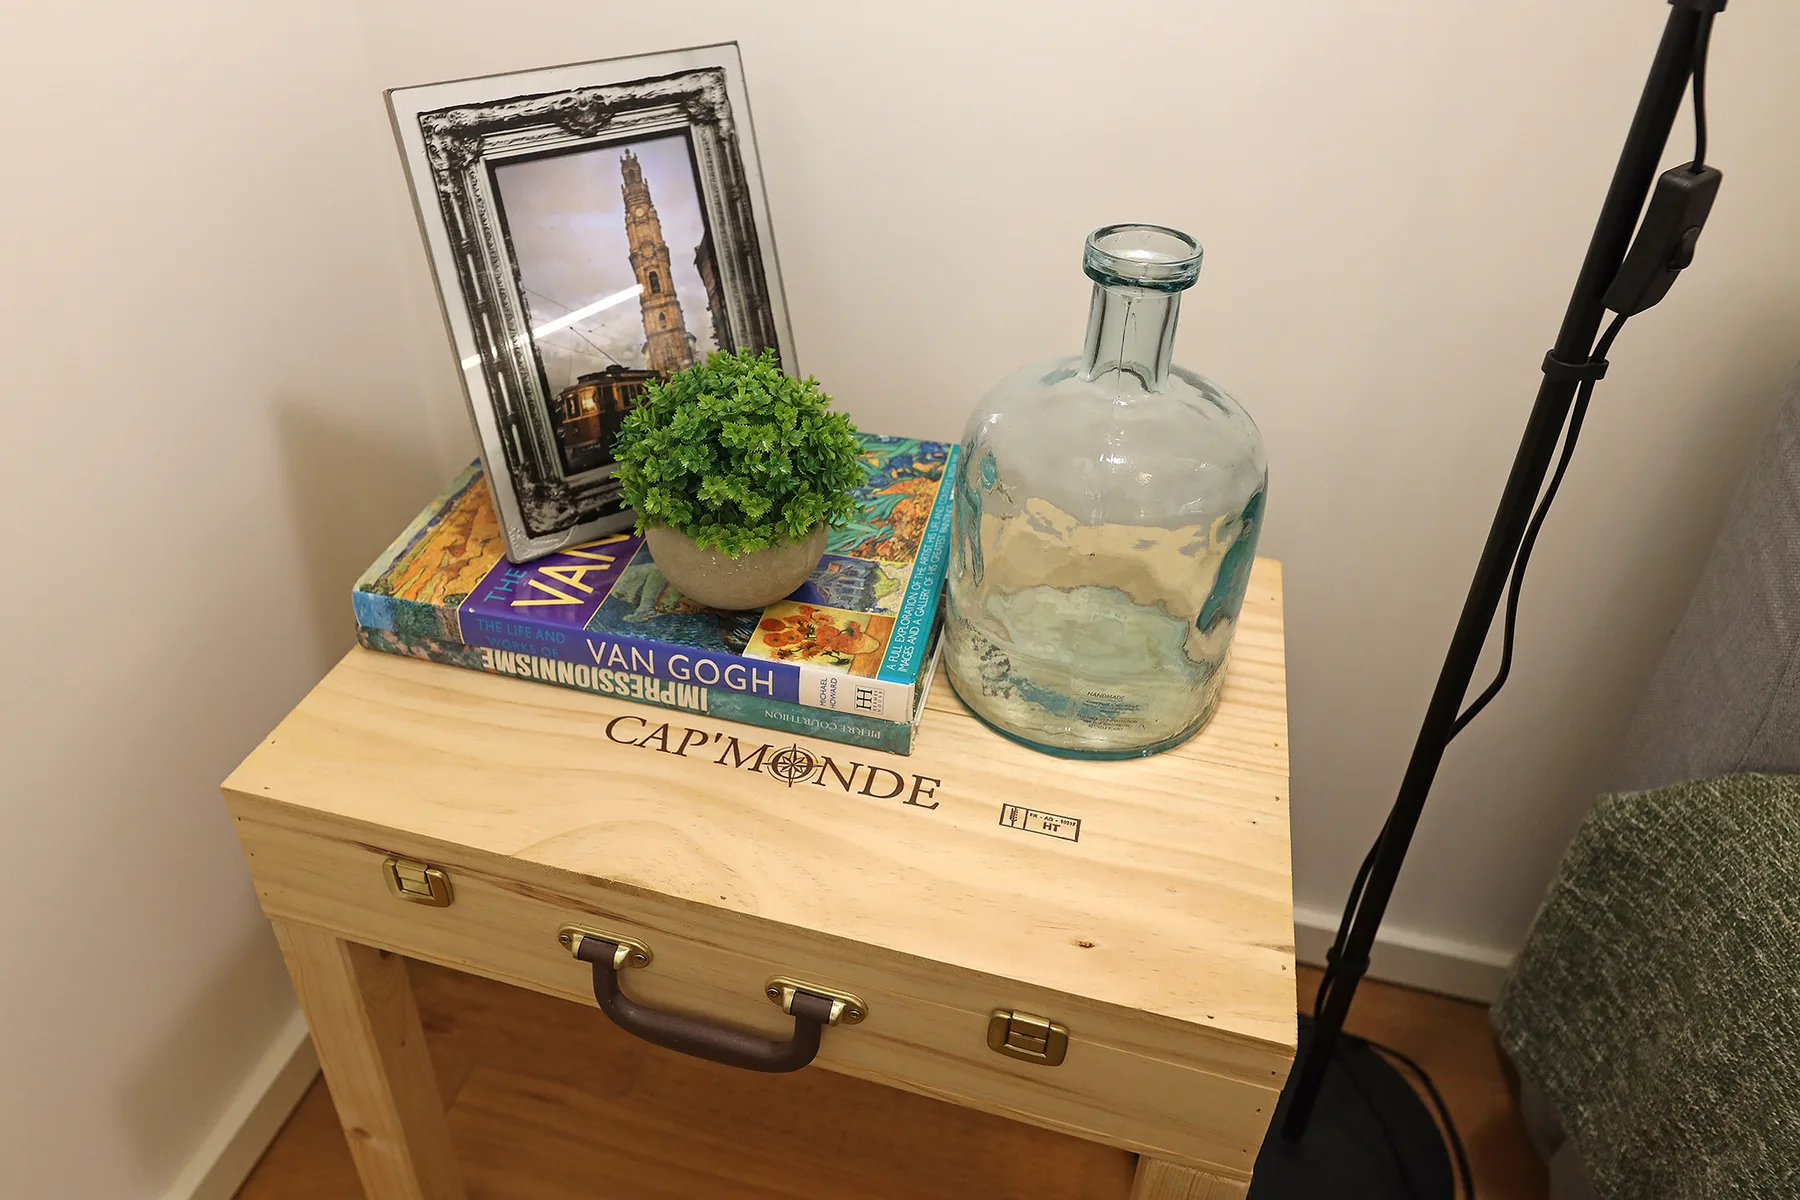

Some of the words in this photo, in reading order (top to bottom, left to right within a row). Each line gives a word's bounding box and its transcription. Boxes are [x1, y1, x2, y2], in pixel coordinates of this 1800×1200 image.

[483, 567, 527, 603] THE
[911, 582, 922, 591] OF
[914, 566, 927, 580] THE
[476, 619, 502, 633] THE
[506, 622, 532, 639] LIFE
[535, 628, 566, 645] AND
[895, 594, 917, 643] EXPLORATION
[898, 645, 915, 673] IMAGES
[907, 627, 920, 645] AND
[915, 589, 931, 618] GALLERY
[923, 577, 934, 587] OF
[487, 636, 537, 654] WORKS
[540, 645, 559, 657] OF
[888, 645, 903, 663] FULL
[481, 645, 708, 712] IMPRESSIONNISME
[586, 638, 655, 675] VAN
[667, 654, 774, 696] GOGH
[820, 678, 828, 706] MICHAEL
[829, 677, 838, 709] HOWARD
[764, 710, 837, 731] COURTHION
[840, 724, 881, 739] PIERRE
[605, 716, 942, 811] CAP'MONDE
[1043, 821, 1061, 832] HT
